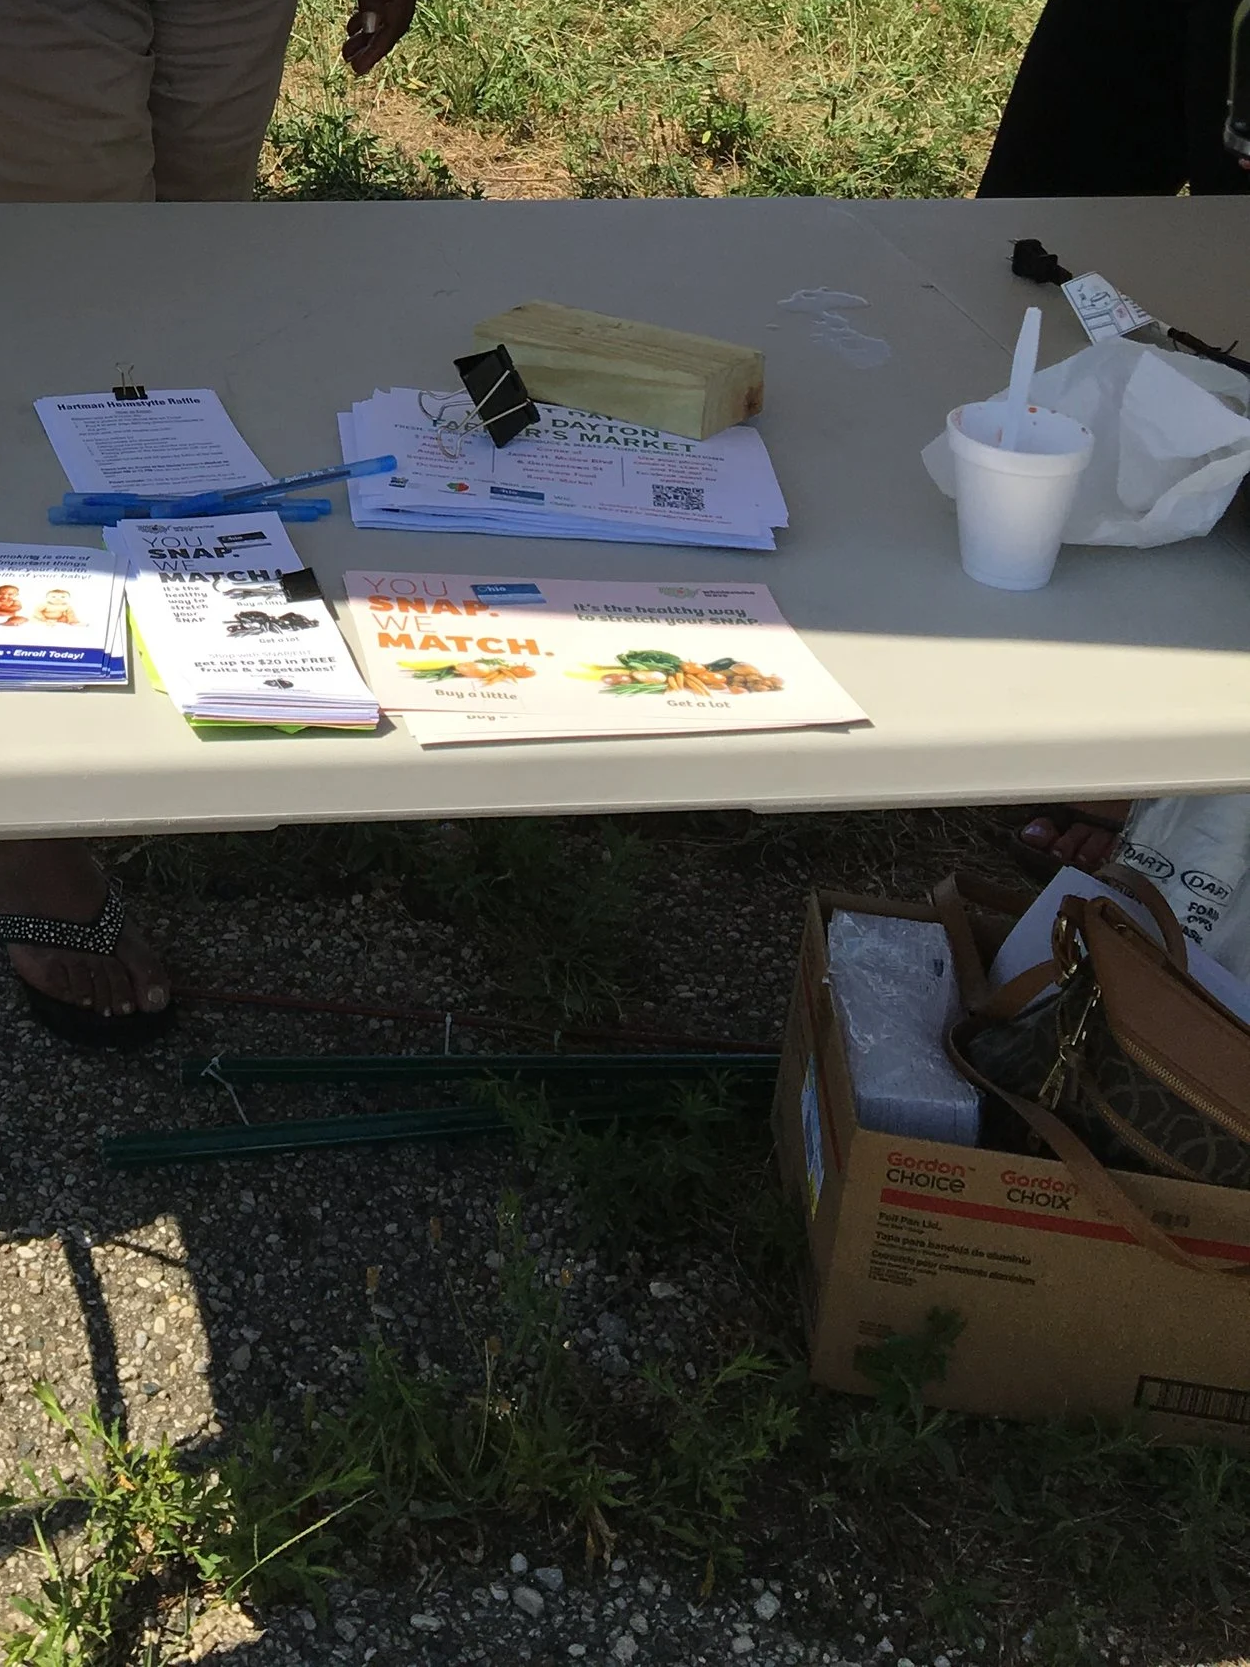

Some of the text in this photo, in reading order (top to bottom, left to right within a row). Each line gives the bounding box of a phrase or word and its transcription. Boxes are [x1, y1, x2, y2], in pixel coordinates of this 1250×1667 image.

[57, 401, 105, 412] Hartman
[168, 397, 201, 406] Raffle
[551, 418, 660, 439] DAYTON
[579, 432, 698, 453] MARKET
[142, 536, 202, 548] YOU
[148, 547, 240, 560] SNAP.
[152, 559, 196, 572] WE
[362, 576, 448, 597] YOU
[368, 595, 500, 617] SNAP.
[573, 603, 747, 618] It's the healthy way
[372, 612, 437, 633] WE
[576, 613, 704, 626] to stretch your
[377, 632, 555, 657] MATCH.
[14, 649, 47, 659] Enroll
[48, 650, 85, 661] Today!
[194, 660, 217, 668] get
[258, 658, 283, 666] $20
[301, 656, 338, 664] FREE
[200, 666, 239, 674] fruits
[435, 688, 518, 701] Buy a little
[666, 699, 732, 709] Get a lot
[1123, 846, 1169, 875] DART
[886, 1151, 966, 1178] Gordon
[1000, 1169, 1079, 1196] Gordon
[1006, 1188, 1073, 1211] CHOIX
[901, 1216, 920, 1227] Pan
[874, 1230, 901, 1244] Tapa
[902, 1236, 926, 1248] para
[927, 1240, 970, 1256] bandeja
[970, 1248, 986, 1258] de
